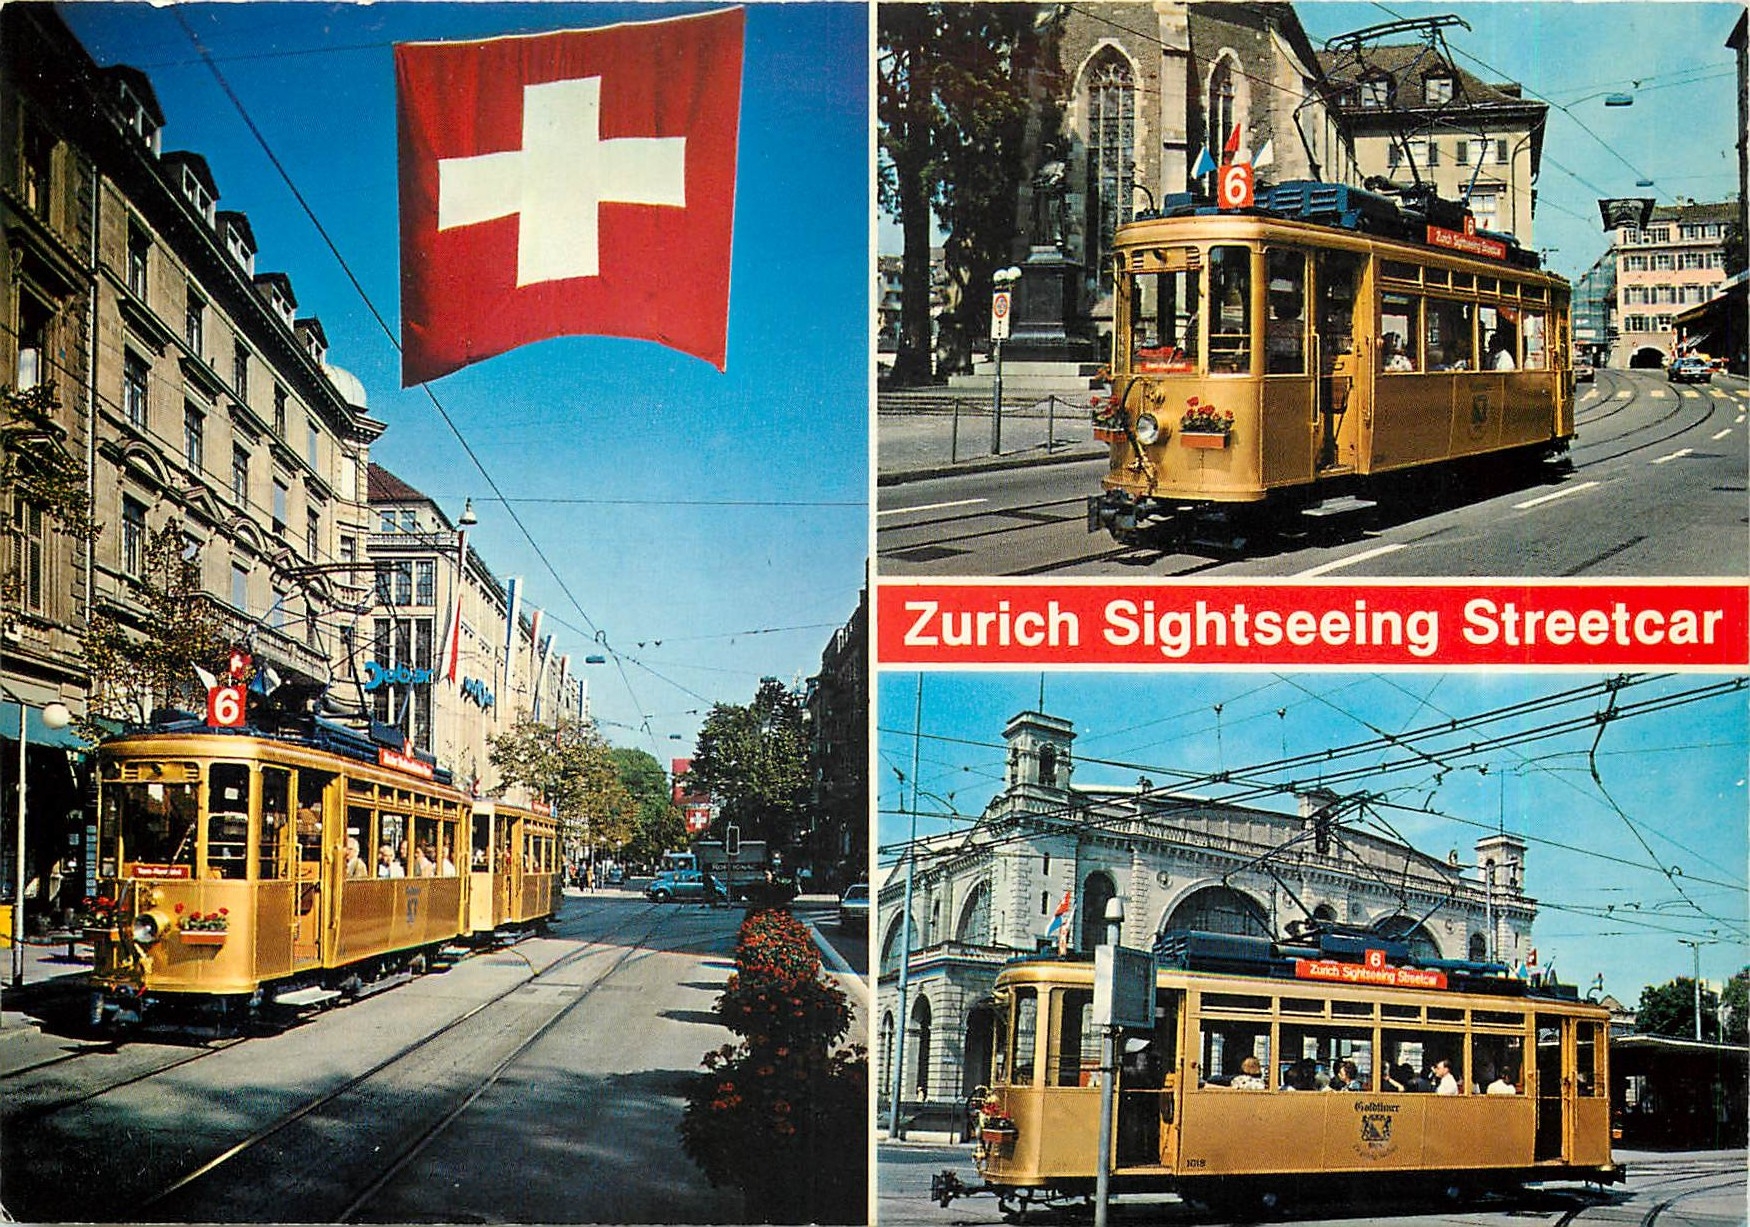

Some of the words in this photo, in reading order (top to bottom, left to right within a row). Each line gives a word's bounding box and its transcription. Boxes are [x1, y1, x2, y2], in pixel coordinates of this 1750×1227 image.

[1225, 166, 1247, 206] 6
[214, 688, 239, 725] 6
[1371, 953, 1381, 967] 6
[1310, 964, 1340, 977] Zurich
[1343, 966, 1396, 984] Sightseeing
[1398, 972, 1437, 986] Streetcar
